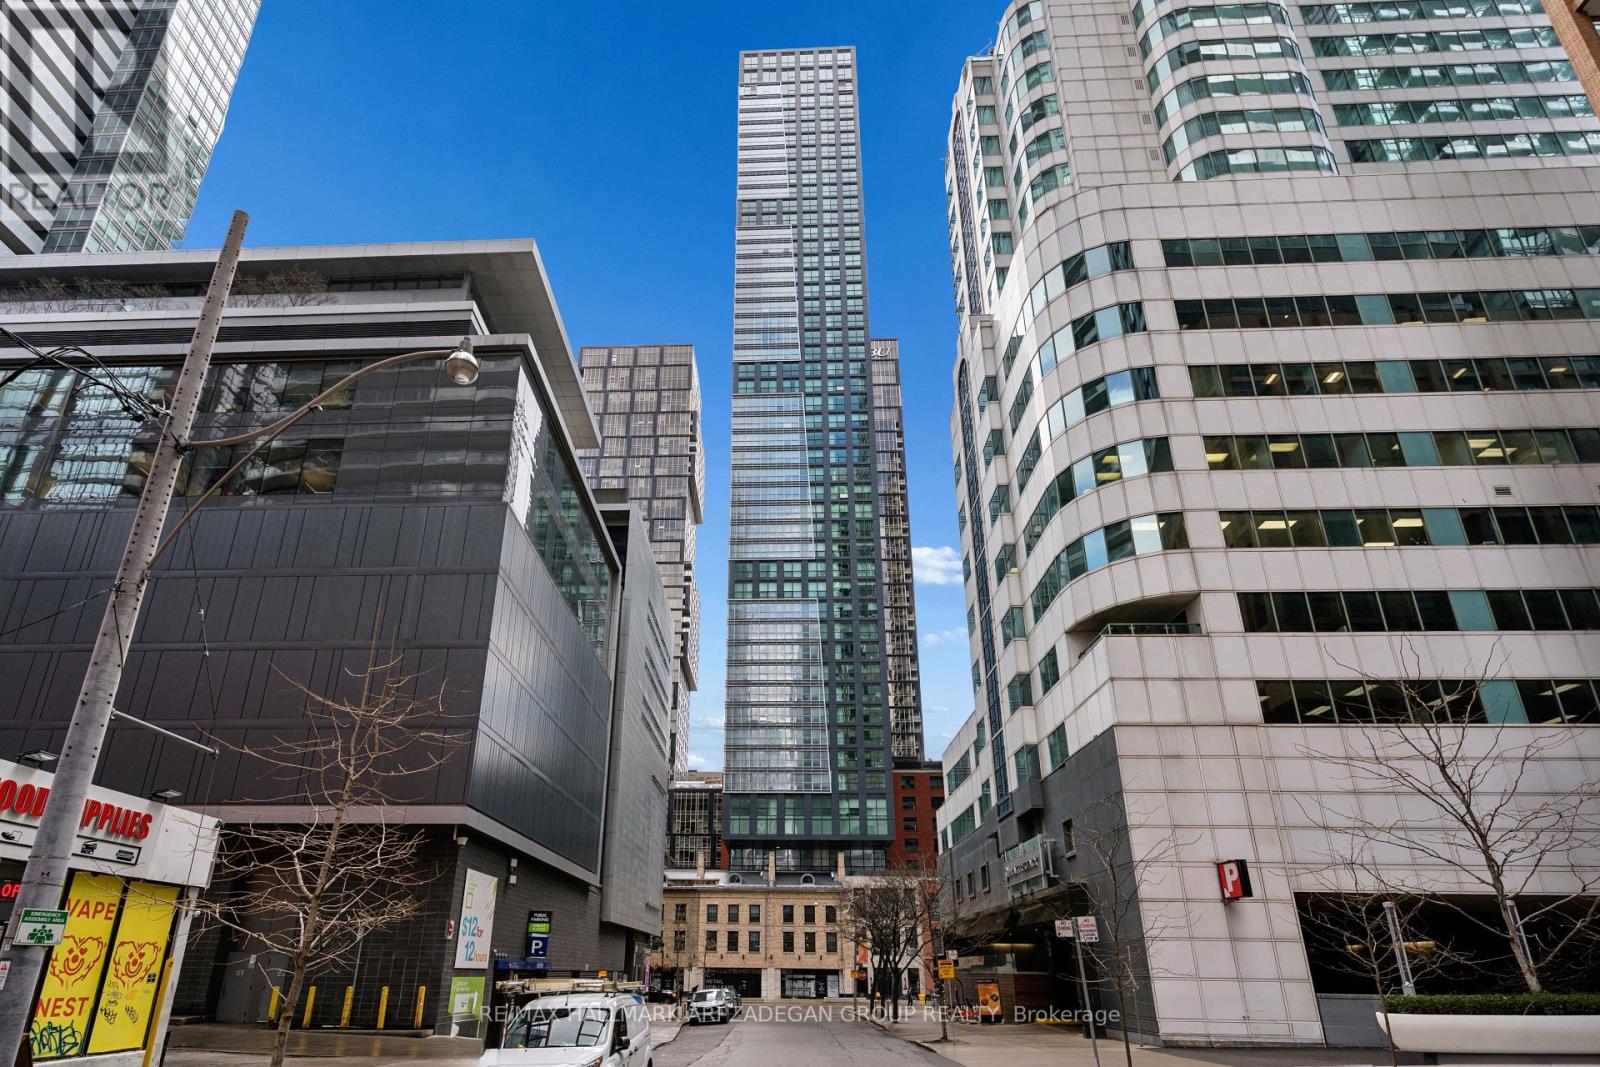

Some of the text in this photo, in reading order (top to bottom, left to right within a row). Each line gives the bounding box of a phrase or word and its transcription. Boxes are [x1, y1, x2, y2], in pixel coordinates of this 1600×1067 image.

[66, 897, 117, 920] VAPE
[464, 940, 476, 961] 12
[531, 939, 543, 954] P
[35, 996, 89, 1018] NEST
